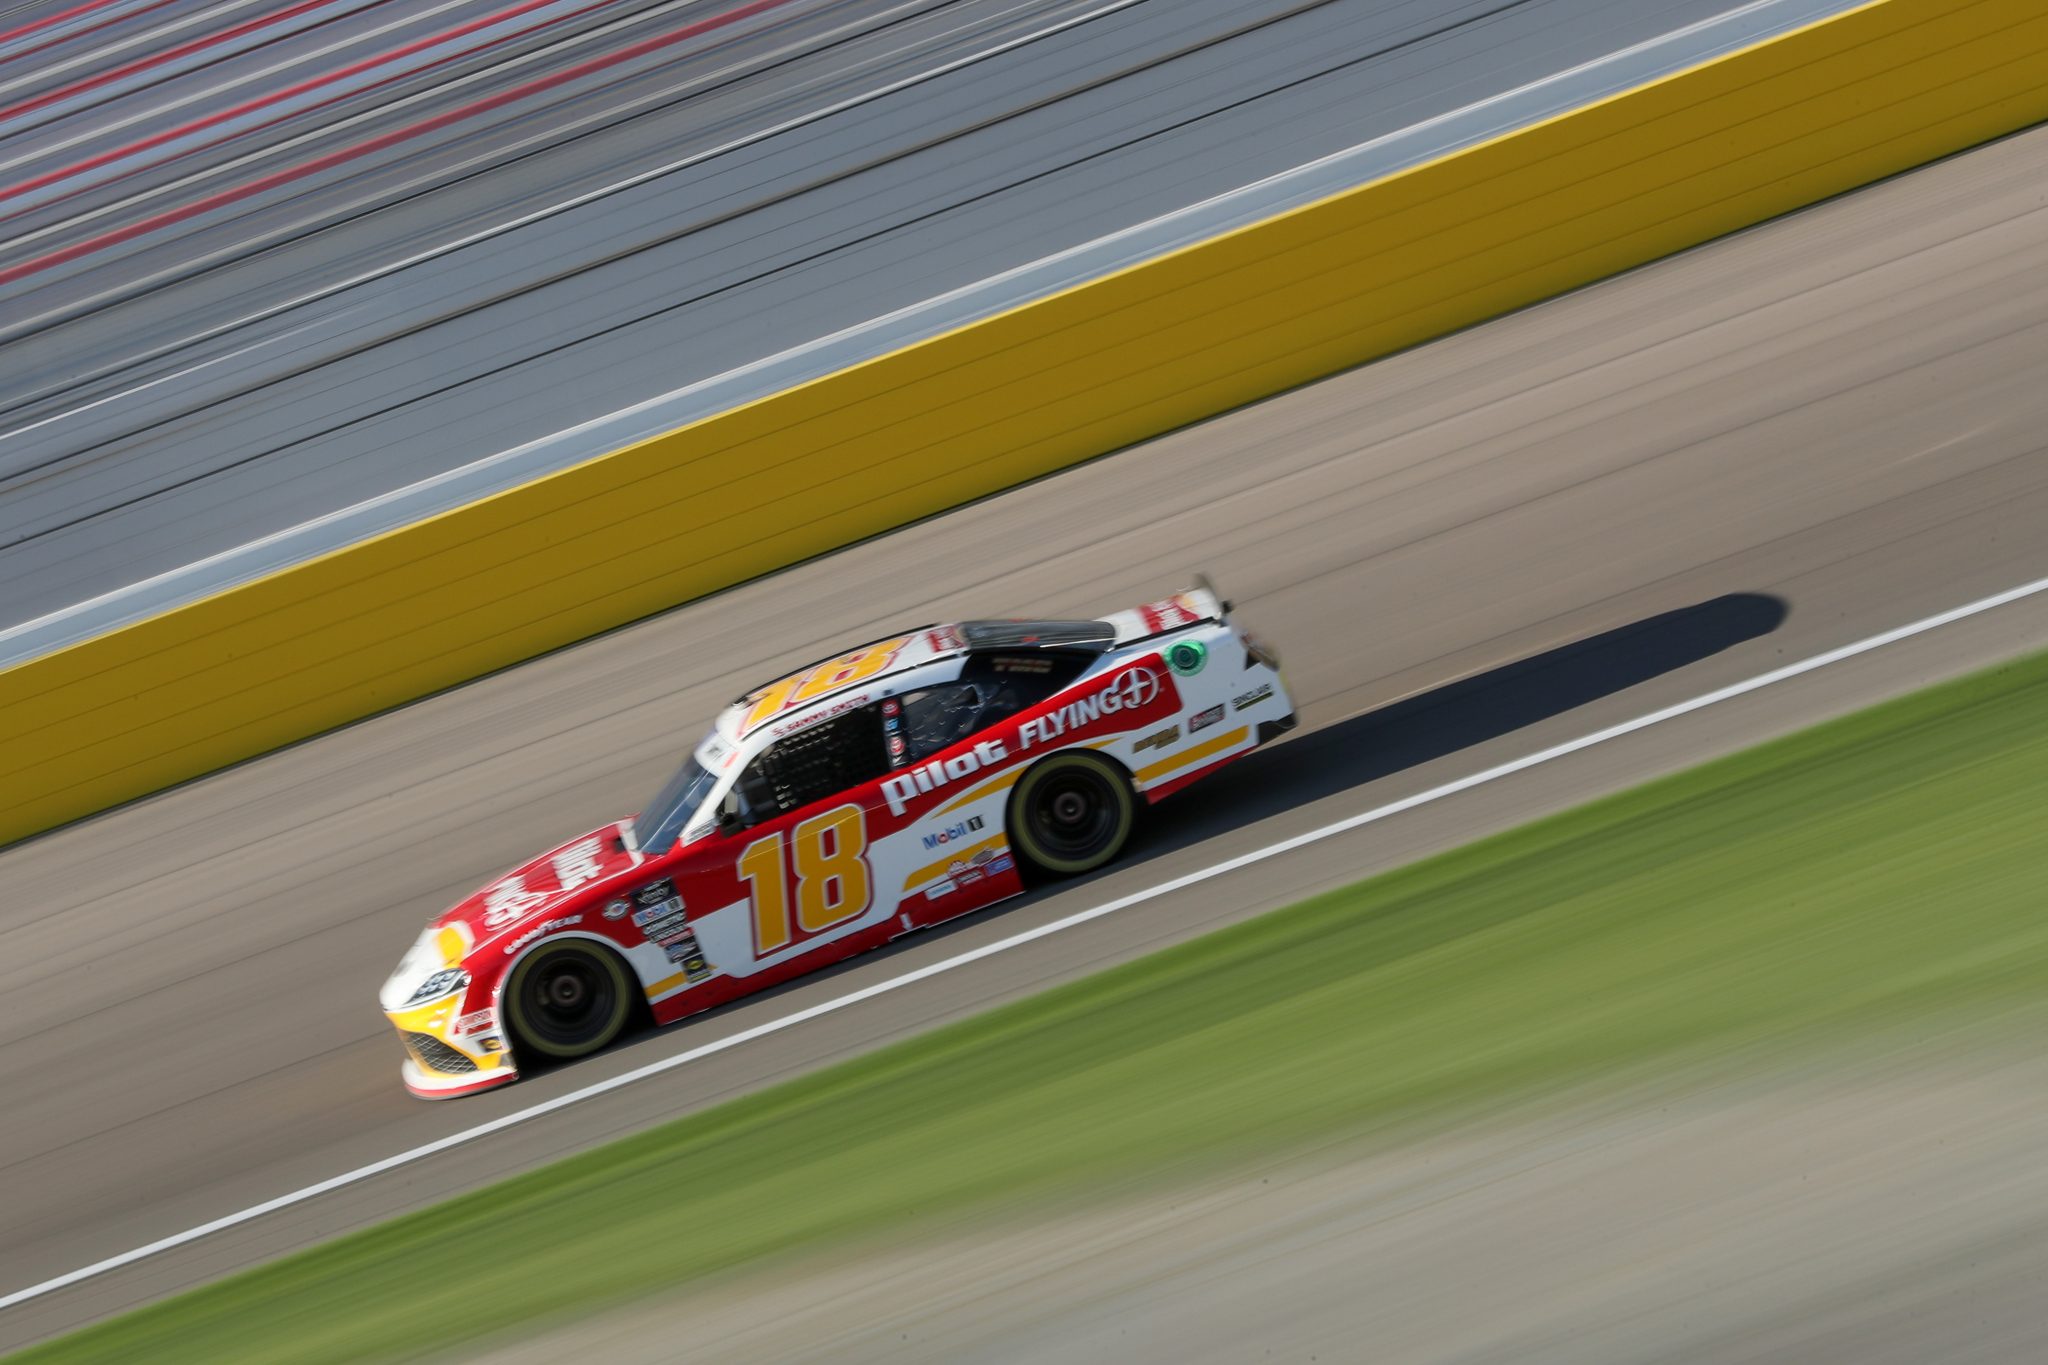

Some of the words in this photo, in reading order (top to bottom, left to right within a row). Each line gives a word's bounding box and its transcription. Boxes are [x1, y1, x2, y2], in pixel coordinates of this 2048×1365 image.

[739, 635, 914, 739] 18
[879, 738, 1008, 817] pilot
[1018, 686, 1123, 749] FLYING
[736, 803, 873, 961] 18
[922, 822, 968, 849] Mobil
[967, 815, 984, 832] 1
